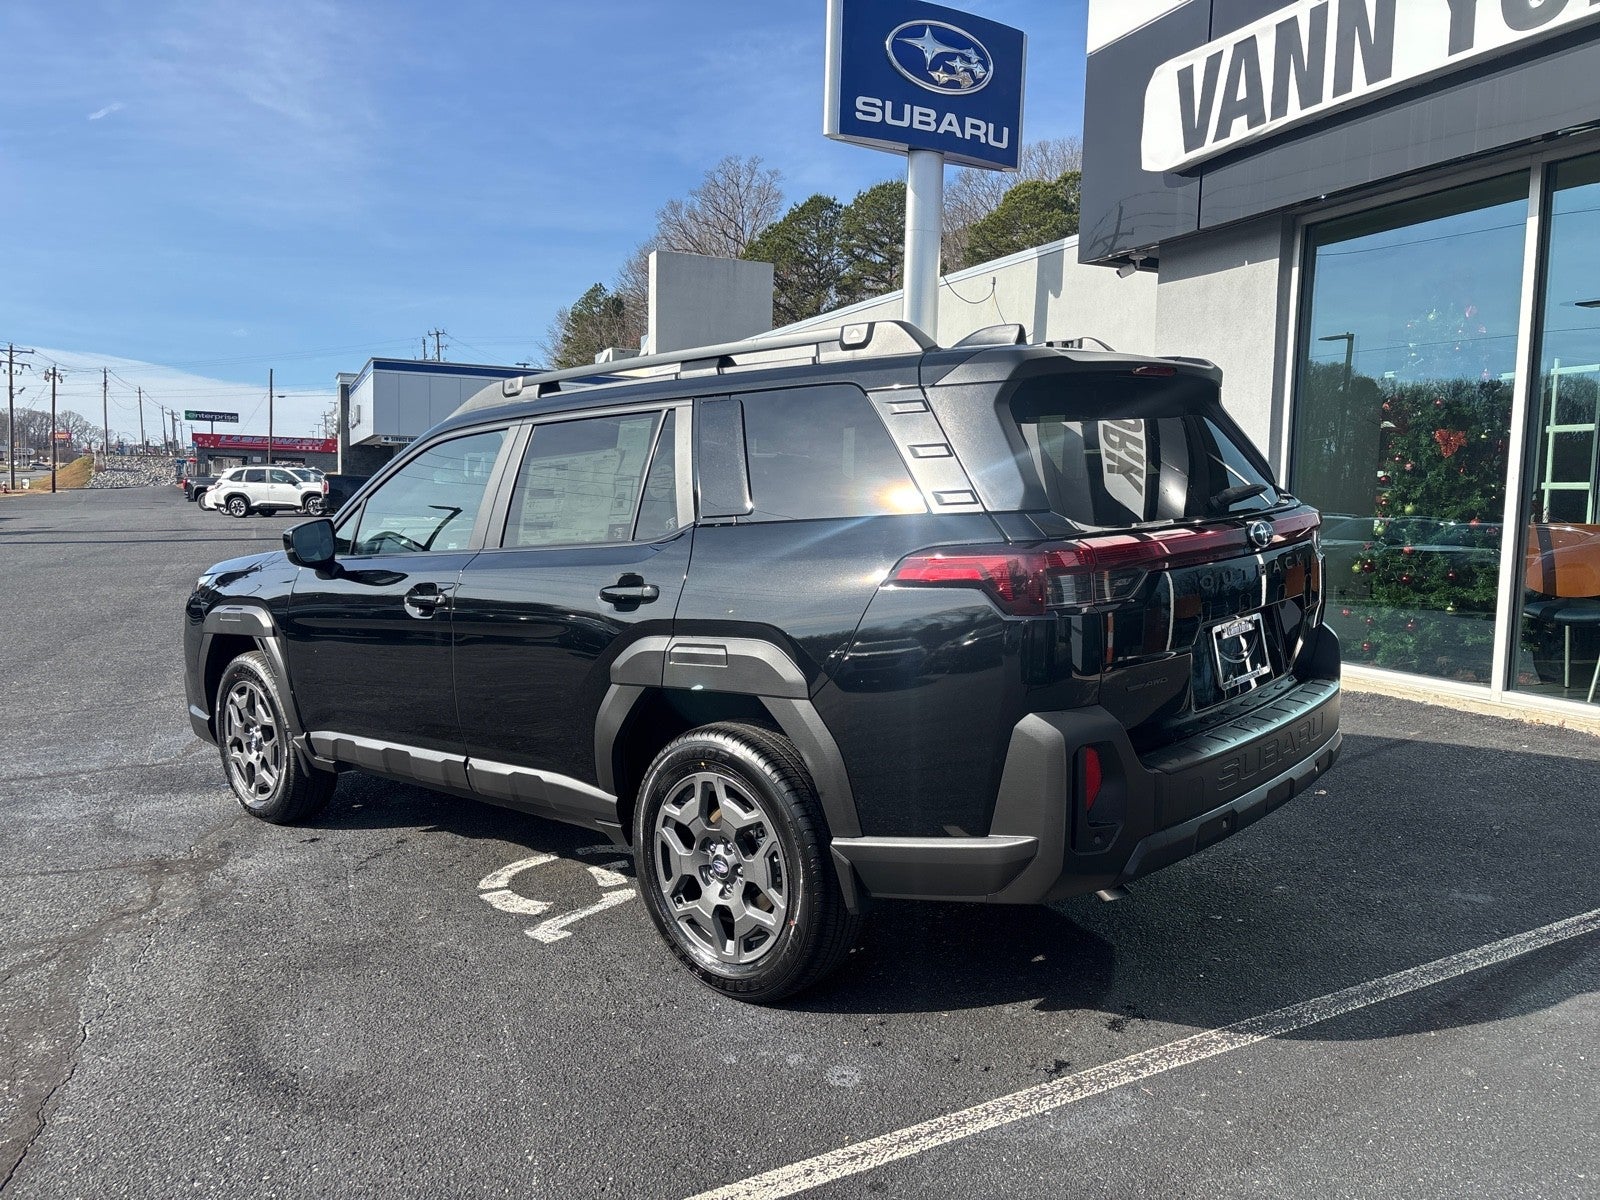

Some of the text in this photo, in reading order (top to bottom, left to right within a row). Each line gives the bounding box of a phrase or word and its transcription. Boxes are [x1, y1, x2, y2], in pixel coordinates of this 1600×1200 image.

[1177, 0, 1398, 154] VANN
[855, 95, 1009, 149] SUBARU
[188, 412, 238, 420] enterprise
[1217, 712, 1324, 791] SUBARU
